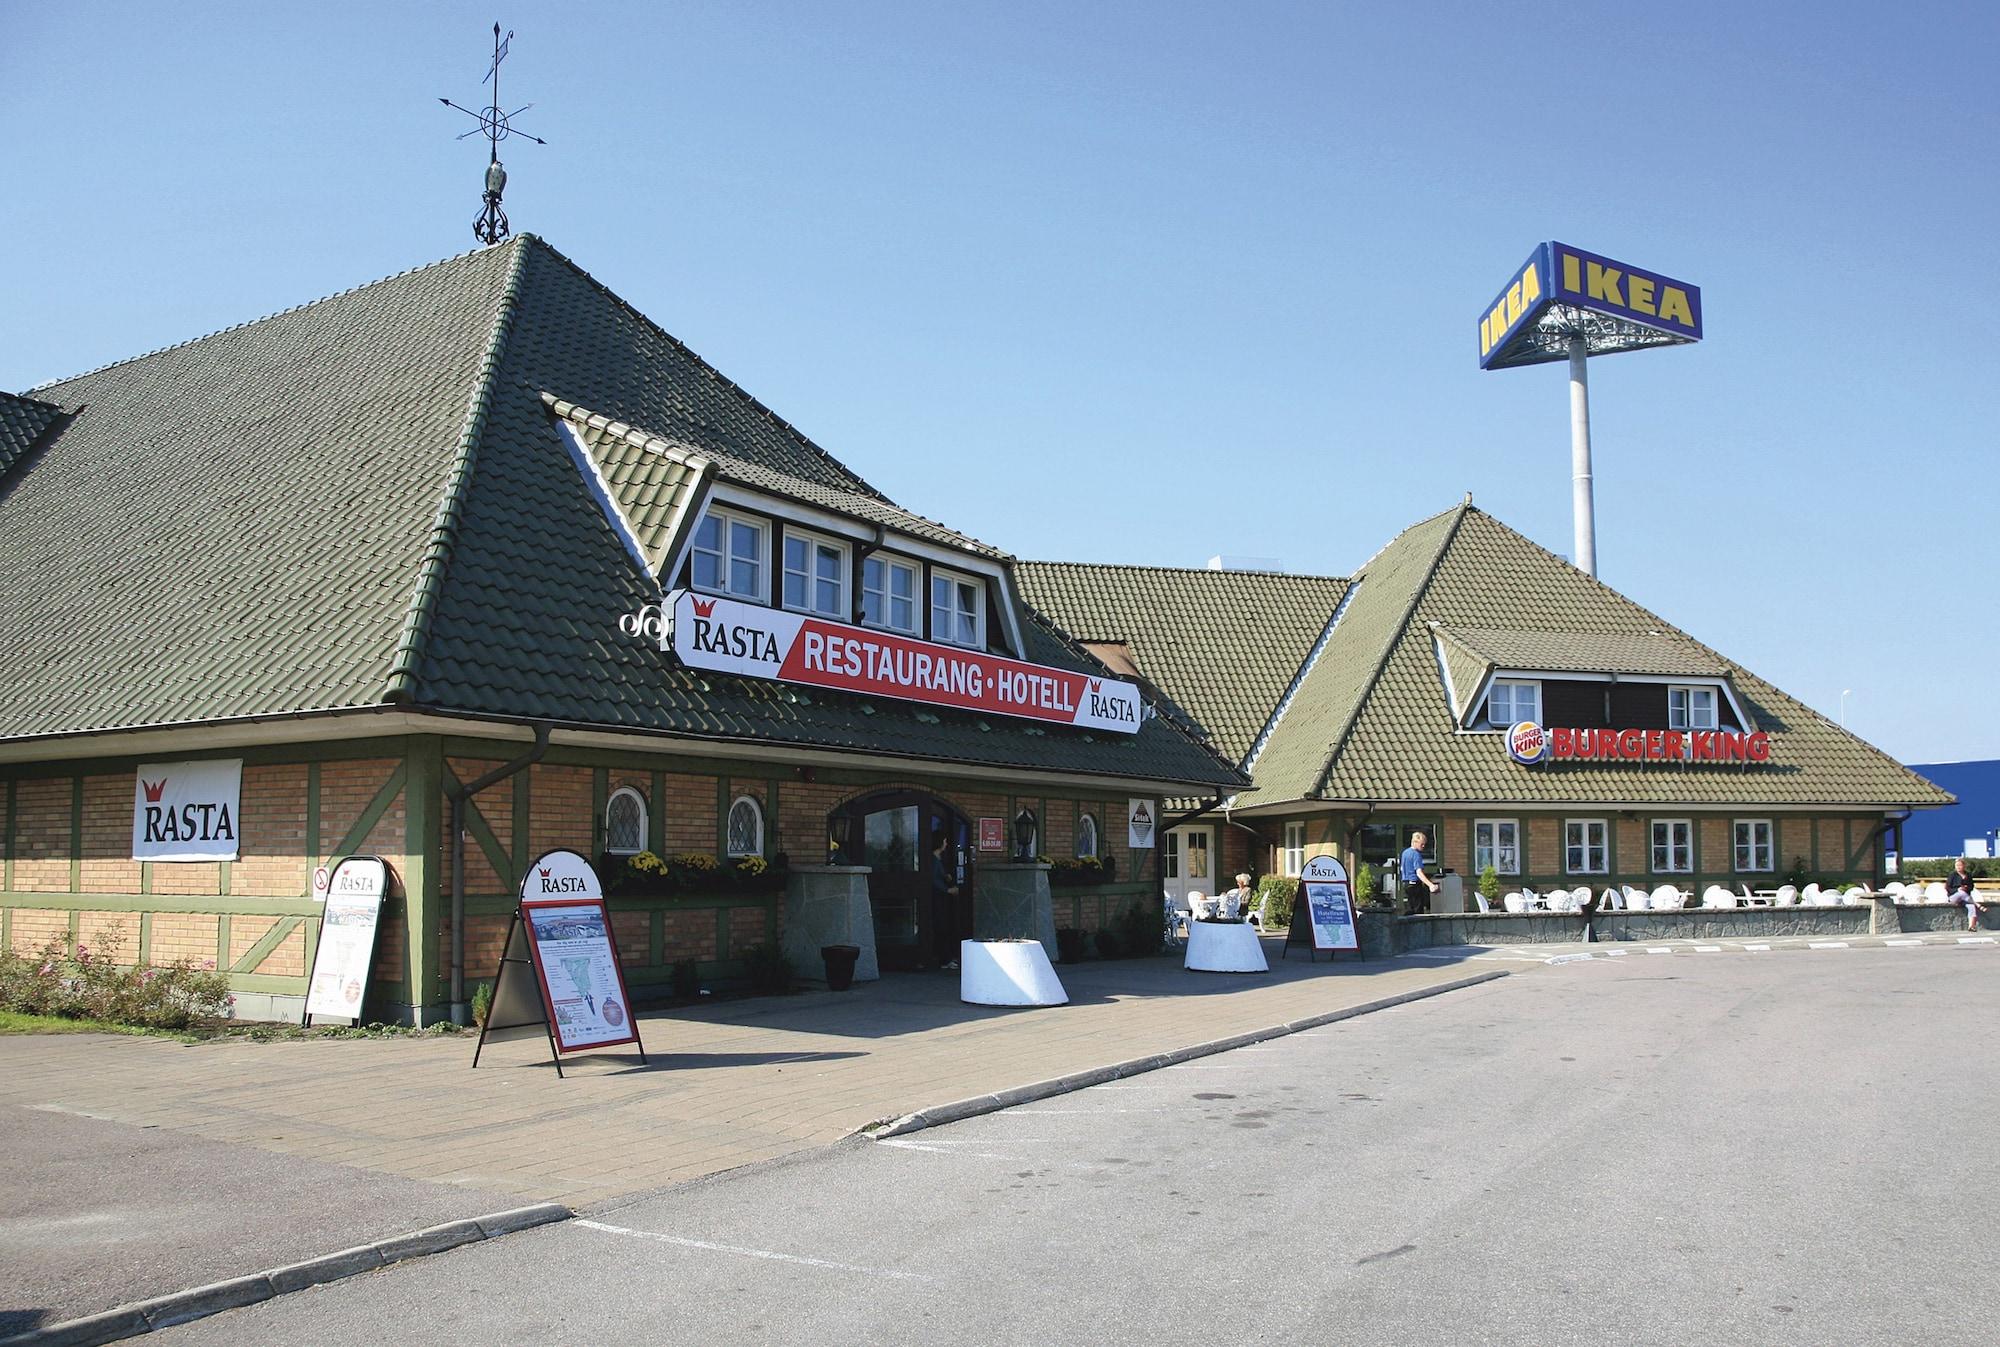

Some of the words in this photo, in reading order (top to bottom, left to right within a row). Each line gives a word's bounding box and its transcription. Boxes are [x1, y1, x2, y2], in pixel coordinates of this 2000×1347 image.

[1562, 254, 1695, 328] IKEA
[1480, 262, 1541, 357] IKEA
[692, 618, 782, 664] RASTA
[804, 631, 983, 698] RESTAURANG
[997, 669, 1074, 713] HOTELL
[1090, 693, 1136, 722] RASTA
[1513, 728, 1542, 744] BURGER
[1515, 736, 1544, 754] KING
[1550, 727, 1684, 760] BURGER
[1691, 731, 1770, 761] KING
[144, 803, 235, 842] RASTA
[340, 876, 373, 891] RASTA
[541, 877, 587, 893] RASTA
[1311, 869, 1337, 877] RASTA
